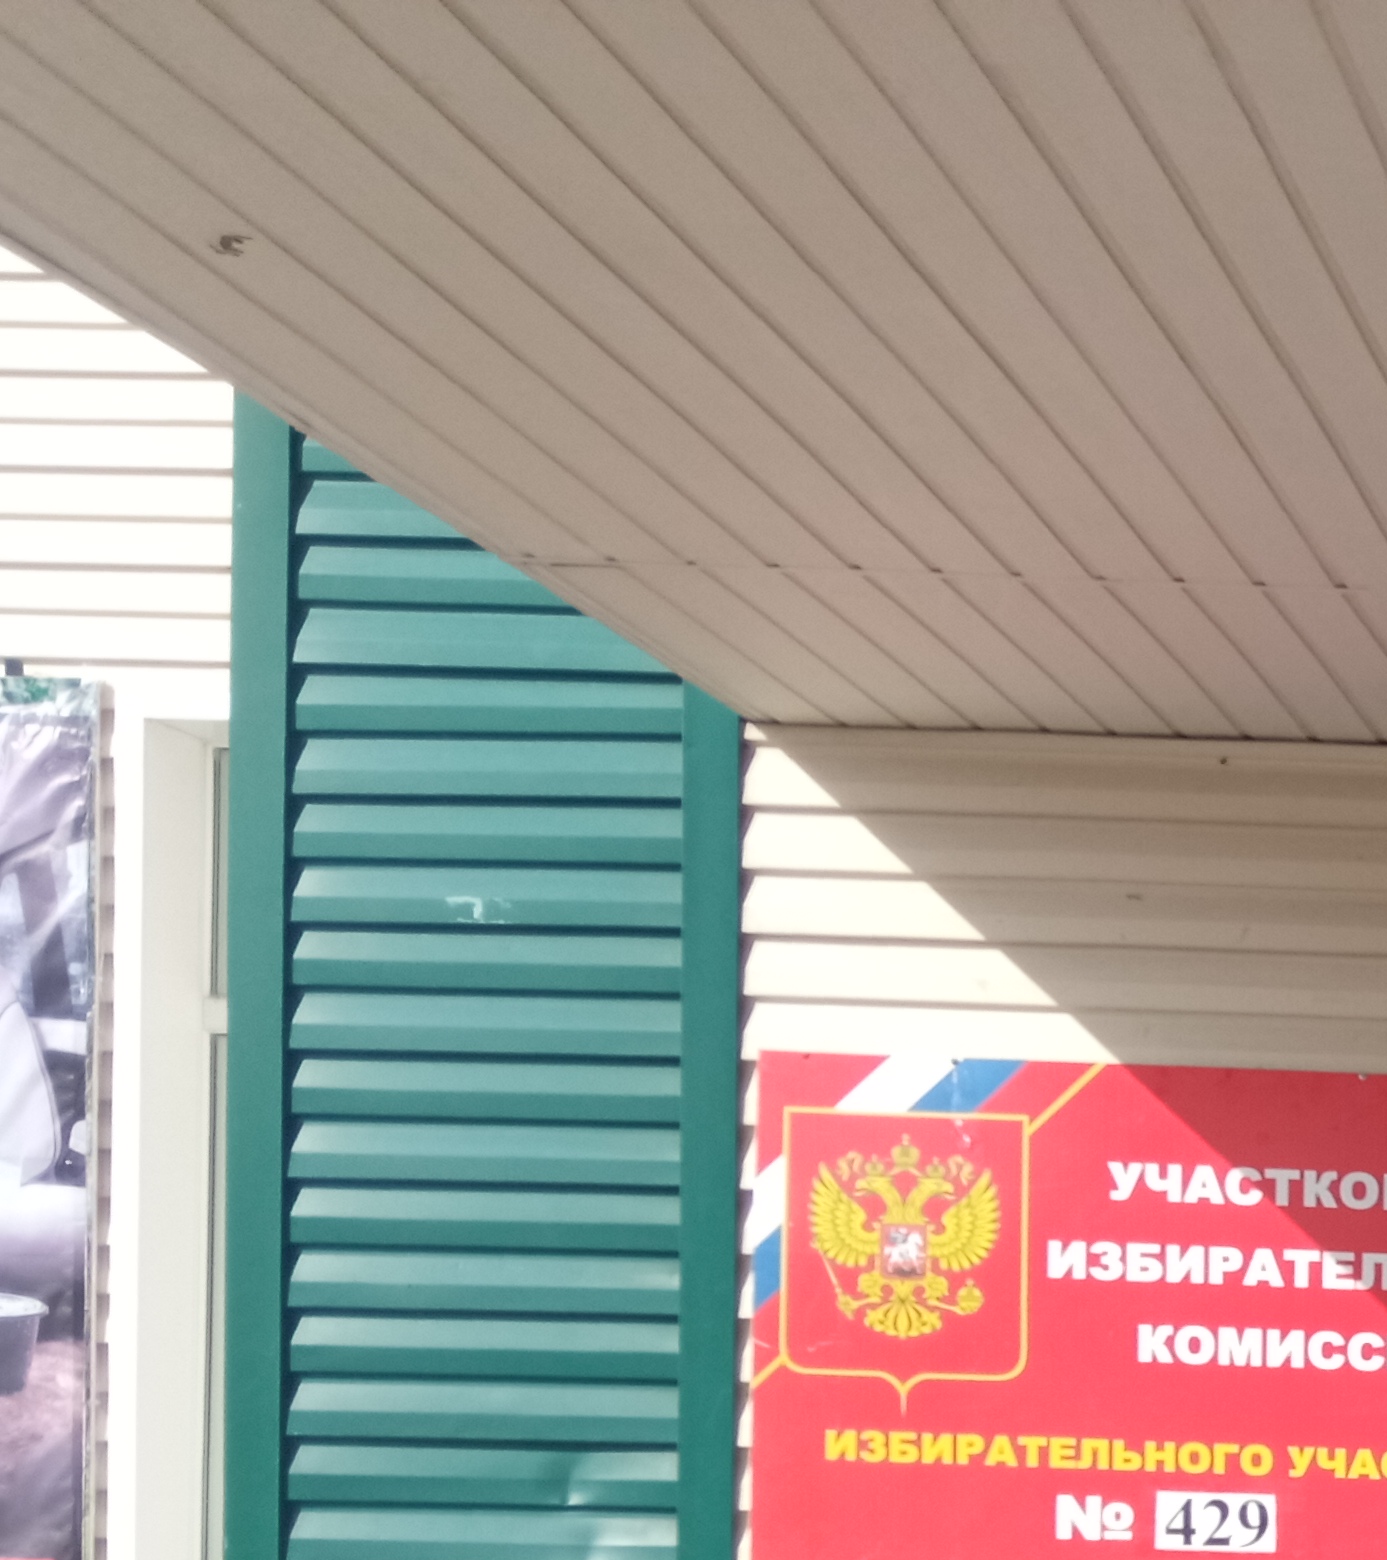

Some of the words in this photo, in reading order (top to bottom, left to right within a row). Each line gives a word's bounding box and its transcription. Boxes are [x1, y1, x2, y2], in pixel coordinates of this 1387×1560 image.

[824, 1429, 1273, 1478] ИЗБИРАТЕЛЬНОГО
[1054, 1494, 1135, 1541] №
[1164, 1498, 1270, 1549] 429
